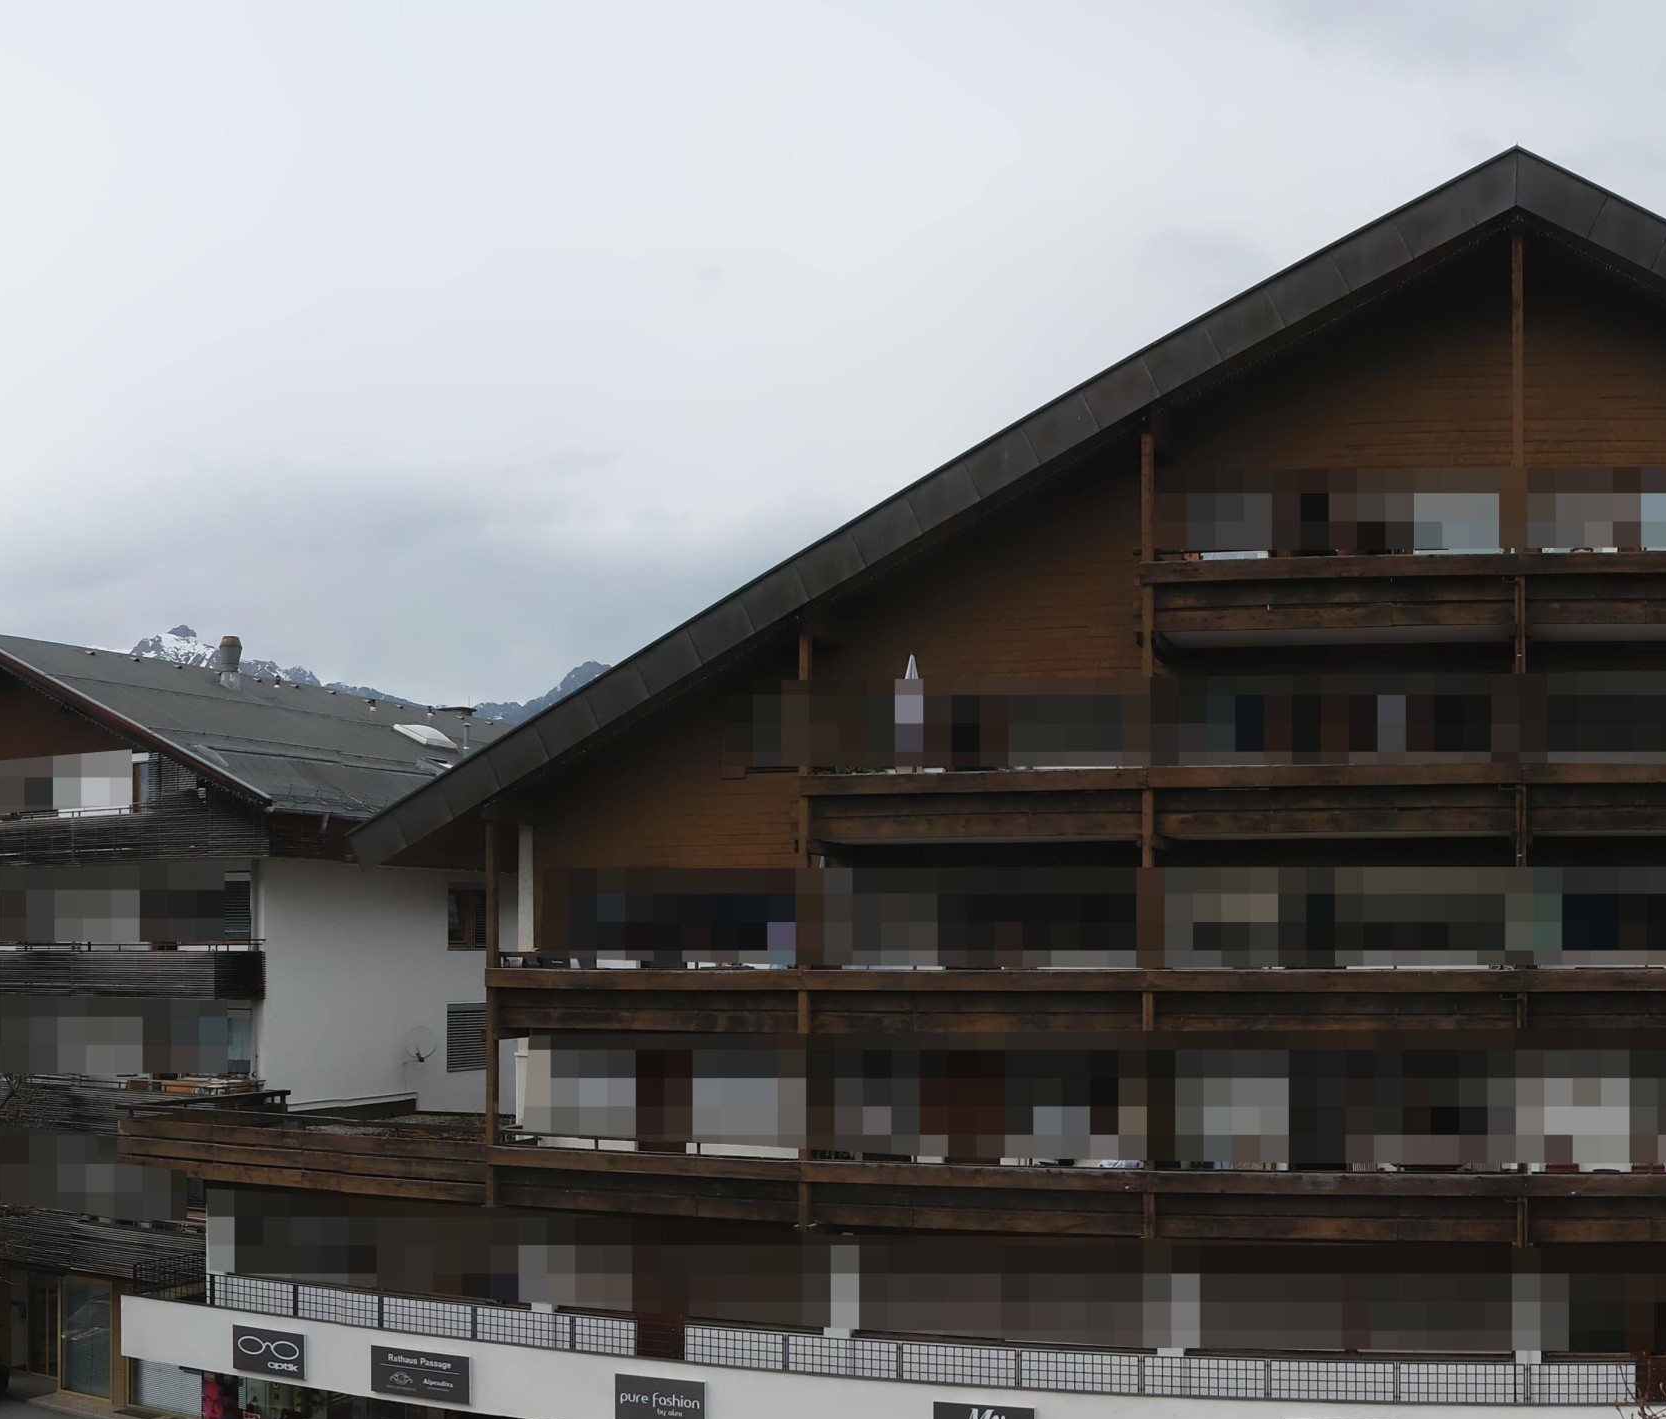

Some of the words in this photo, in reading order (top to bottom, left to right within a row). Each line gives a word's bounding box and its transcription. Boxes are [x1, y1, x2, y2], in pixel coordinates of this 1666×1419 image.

[267, 1360, 299, 1373] optik
[388, 1353, 418, 1365] Rathaus
[420, 1357, 452, 1370] Passage
[620, 1392, 649, 1404] pure
[652, 1392, 700, 1409] fashion
[657, 1408, 666, 1417] by
